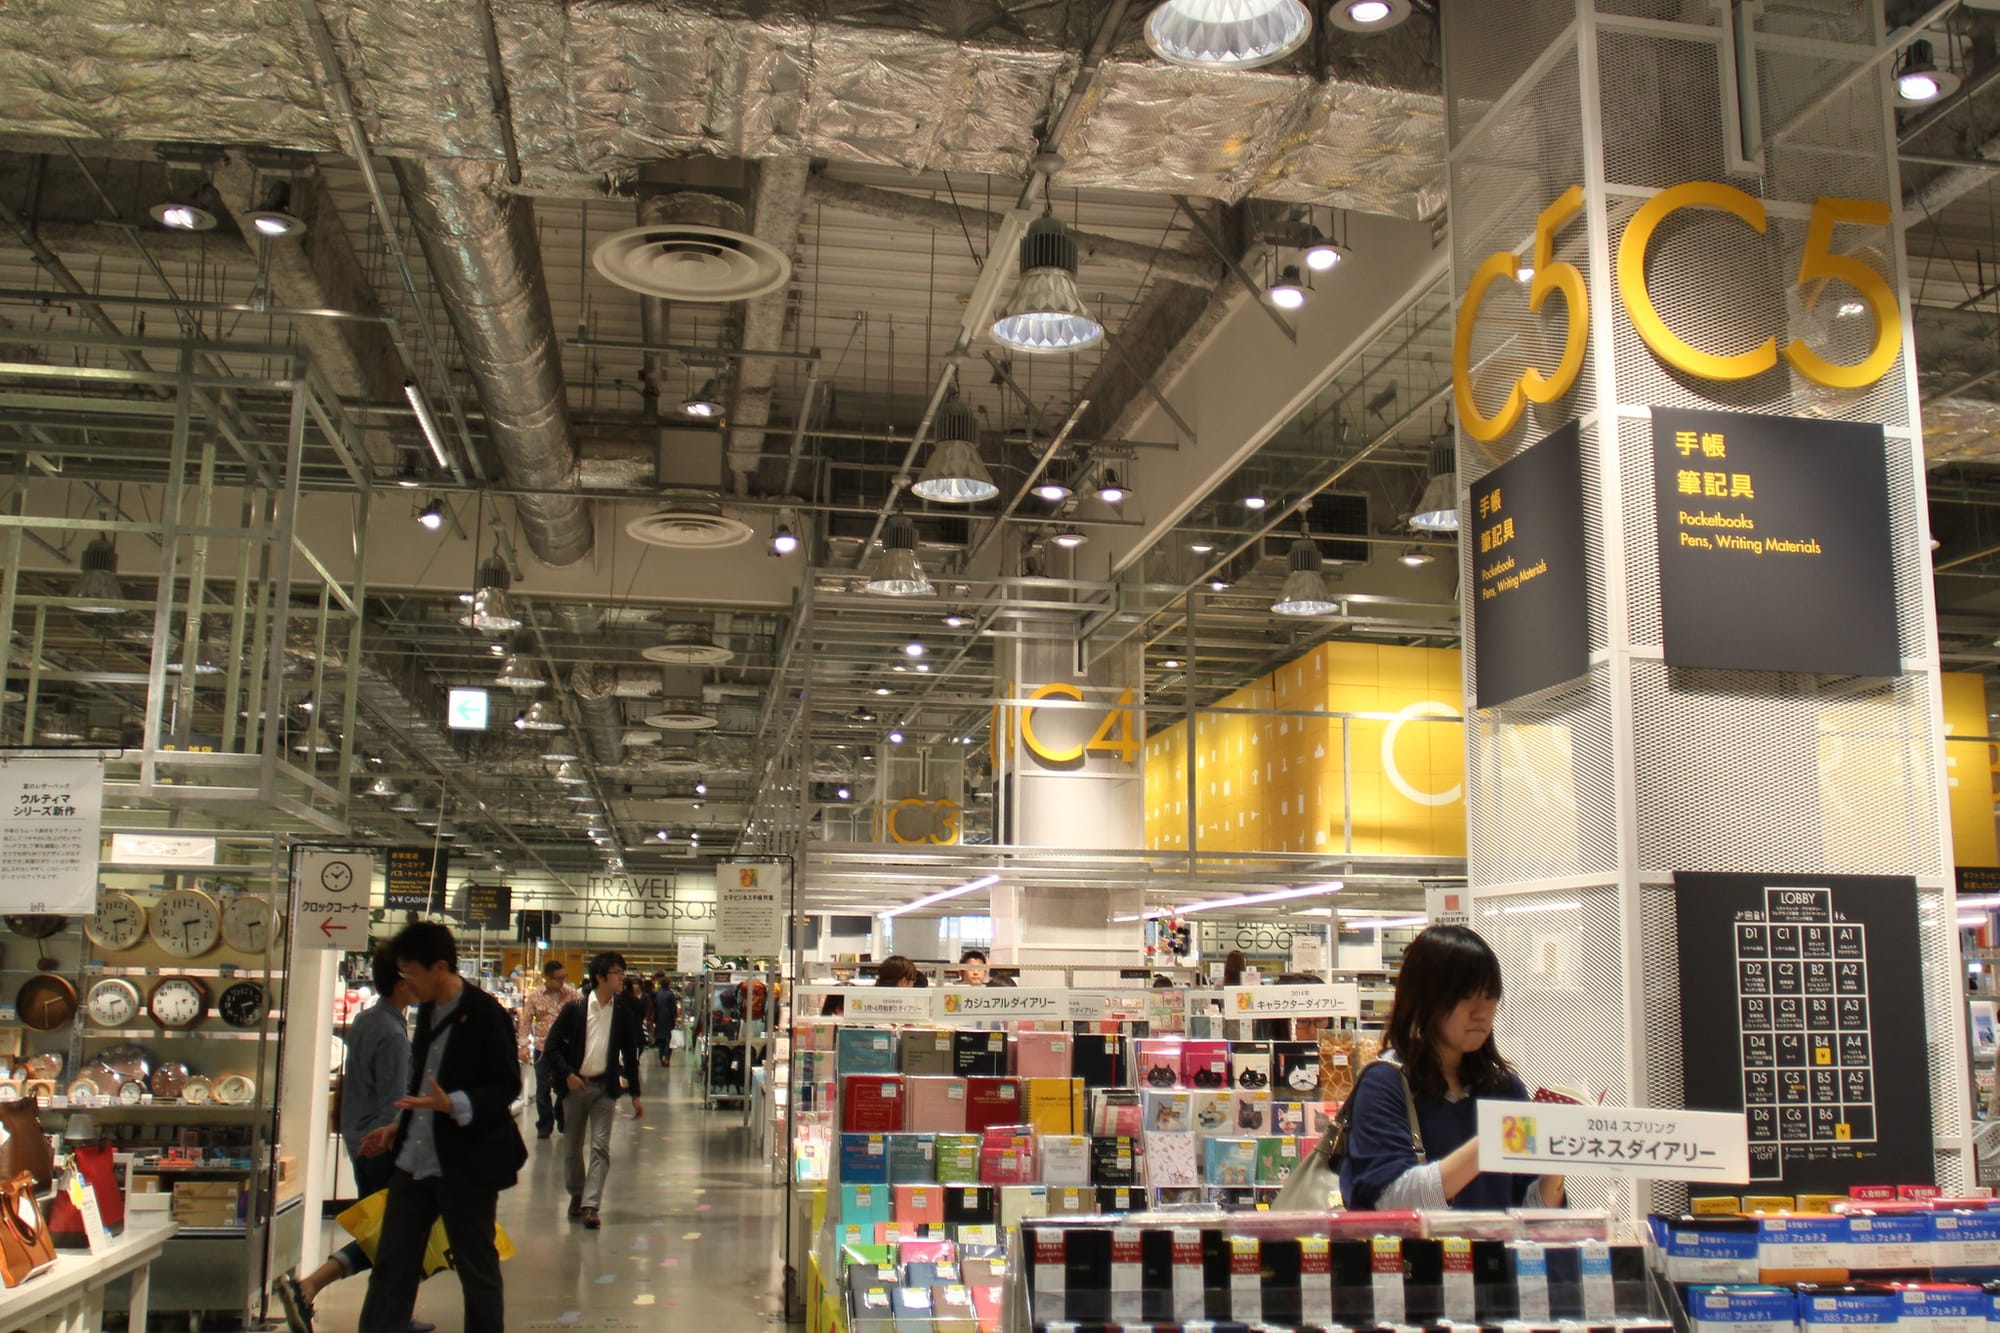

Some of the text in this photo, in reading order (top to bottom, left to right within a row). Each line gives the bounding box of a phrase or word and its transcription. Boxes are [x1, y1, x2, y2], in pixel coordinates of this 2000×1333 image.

[1617, 181, 1902, 388] C5
[1453, 185, 1588, 441] C5
[1676, 431, 1726, 458] 手帳
[1677, 469, 1754, 499] 筆記具
[1480, 488, 1502, 519] 手帳
[1679, 510, 1754, 529] Pocketbooks
[1680, 532, 1822, 555] Pens, Writing Materials
[1021, 682, 1141, 762] C4
[19, 794, 71, 805] ウルティマ
[13, 806, 76, 817] シリーズ新作
[888, 798, 959, 845] C3
[588, 877, 672, 898] TRAVEL
[1780, 892, 1816, 904] LOBBY
[302, 902, 369, 913] クロックコーナー
[1745, 928, 1758, 939] D1
[1777, 928, 1790, 939] C1
[1810, 928, 1821, 939] B1
[1840, 928, 1853, 940] A1
[1747, 964, 1762, 975] D2
[1778, 963, 1794, 975] C2
[1811, 964, 1825, 975] B2
[1842, 964, 1858, 976] A2
[964, 997, 1056, 1010] カジュアルダイアリー
[1257, 999, 1345, 1010] キャラクターダイアリー
[1749, 1000, 1764, 1011] D3
[1780, 1000, 1796, 1011] C3
[1813, 1000, 1827, 1011] B3
[1844, 1000, 1859, 1011] A3
[1751, 1036, 1766, 1047] D4
[1782, 1036, 1798, 1047] C4
[1815, 1036, 1829, 1047] B4
[1846, 1036, 1862, 1047] A4
[1752, 1072, 1768, 1084] D5
[1784, 1072, 1800, 1084] C5
[1817, 1072, 1831, 1084] B5
[1848, 1072, 1864, 1083] A5
[1754, 1109, 1770, 1121] D6
[1786, 1109, 1802, 1121] C6
[1819, 1108, 1833, 1120] B6
[1587, 1119, 1676, 1134] 2014 スプリング
[1549, 1136, 1717, 1162] ビジネスダイアリー
